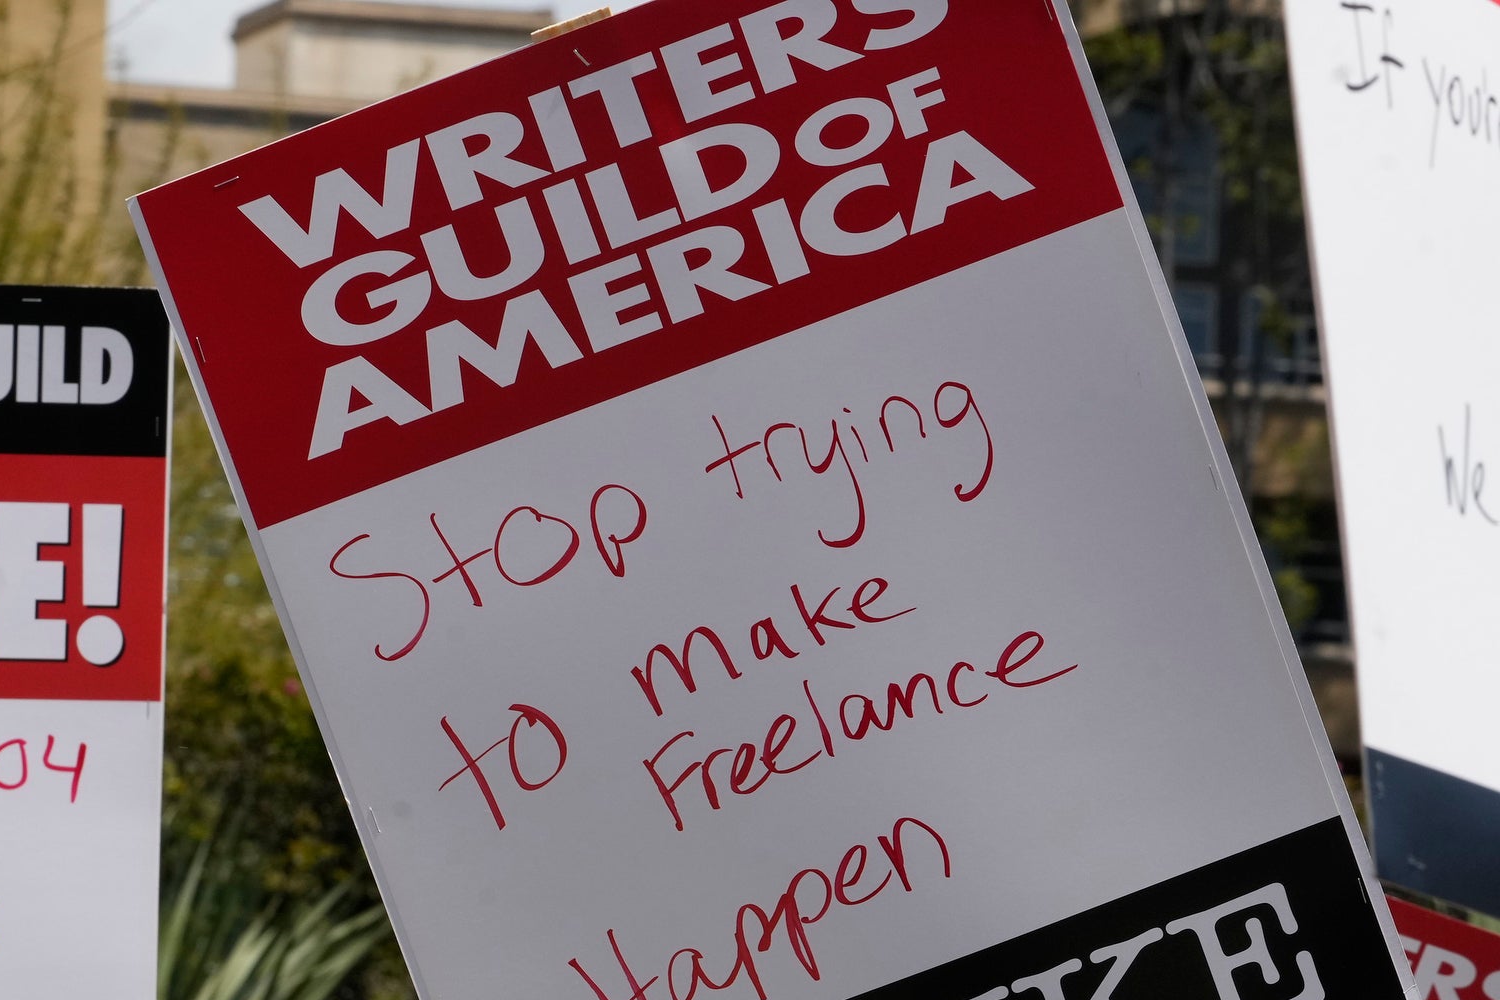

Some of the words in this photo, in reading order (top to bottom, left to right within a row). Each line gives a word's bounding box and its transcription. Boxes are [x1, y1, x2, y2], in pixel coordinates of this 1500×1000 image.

[237, 0, 949, 269] WRITERS
[1340, 2, 1404, 110] If
[299, 122, 780, 346] GUILD
[794, 66, 947, 167] OF
[307, 130, 1036, 461] AMERICA
[329, 483, 648, 662] Stop
[705, 381, 994, 549] trying
[438, 703, 568, 831] to
